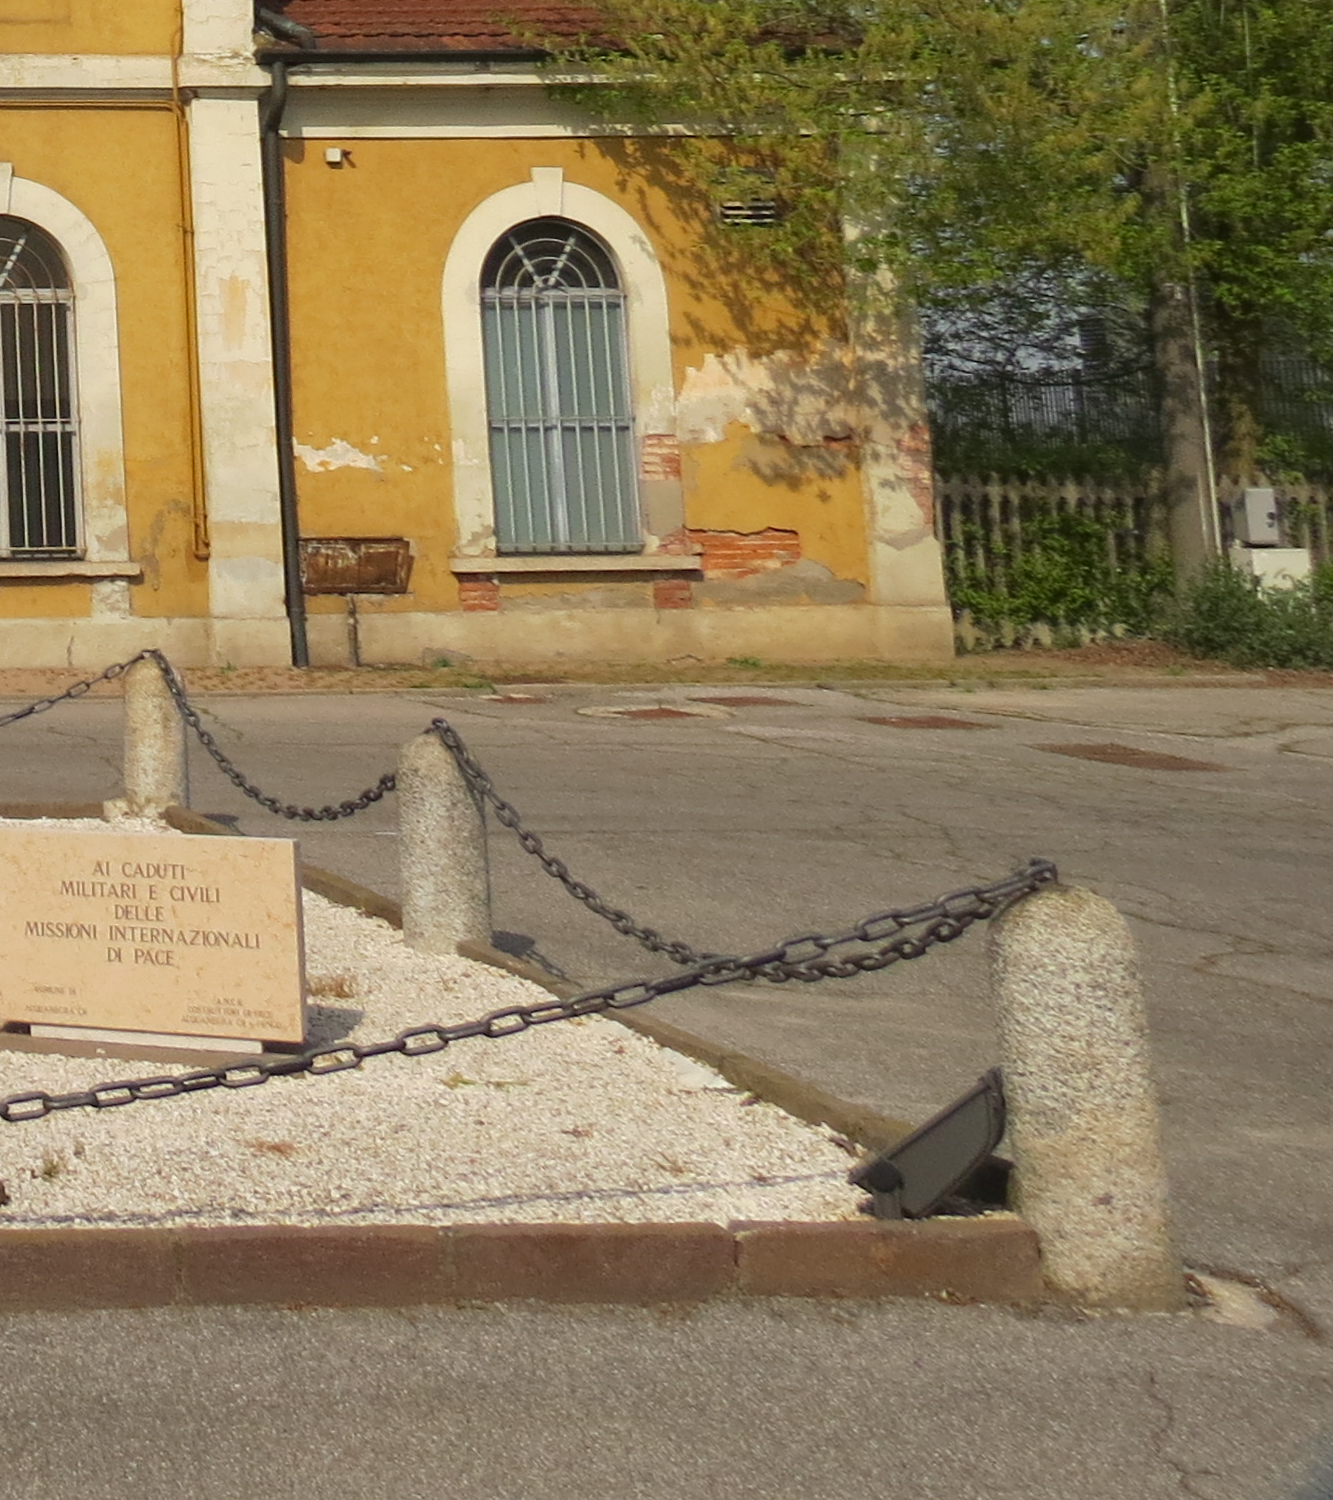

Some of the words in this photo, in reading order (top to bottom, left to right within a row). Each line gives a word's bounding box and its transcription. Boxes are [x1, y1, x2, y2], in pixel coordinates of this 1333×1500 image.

[92, 861, 110, 877] AI
[121, 862, 186, 881] CADUTI
[60, 880, 137, 900] MILITARI
[148, 884, 158, 900] E
[169, 885, 221, 904] CIVILI
[114, 904, 165, 922] DELLE
[24, 920, 98, 940] MISSIONI
[108, 924, 261, 950] INTERNAZIONALI
[107, 947, 123, 963] DI
[134, 950, 175, 967] PACE
